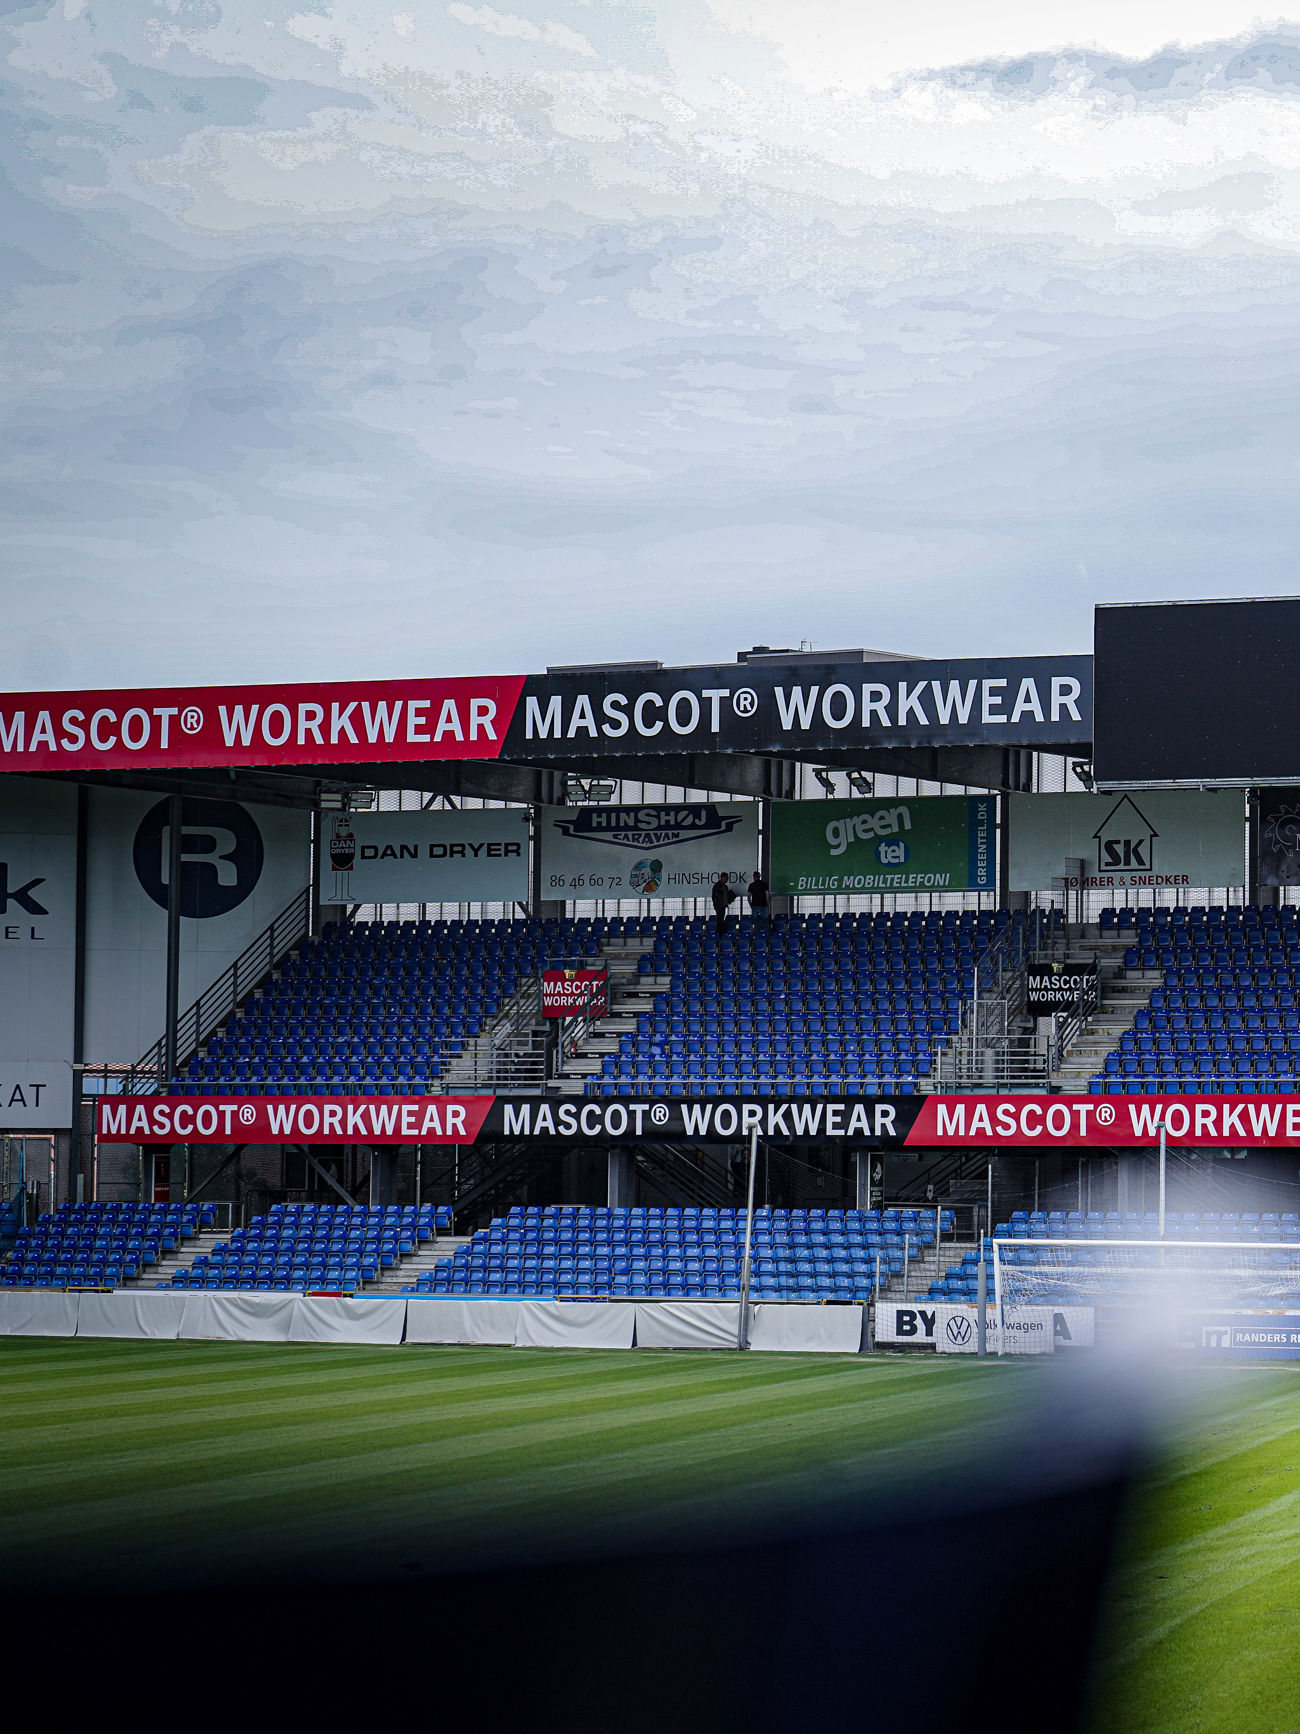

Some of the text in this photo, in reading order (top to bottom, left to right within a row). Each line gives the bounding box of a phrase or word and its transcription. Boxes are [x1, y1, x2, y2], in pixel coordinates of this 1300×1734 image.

[526, 677, 1082, 739] MASCOT® WORKWEAR
[0, 698, 497, 752] MASCOT® WORKWEAR
[592, 809, 707, 829] HINSHØJ
[825, 805, 912, 856] green
[331, 840, 354, 848] DAN
[612, 831, 680, 845] CARAVAN
[977, 802, 987, 884] GREENTEL.DK
[360, 842, 521, 860] DAN DRYER
[878, 841, 905, 864] tel
[1104, 838, 1146, 867] SK
[550, 873, 622, 889] 86 46 60 72
[798, 875, 839, 890] BILLIG
[842, 873, 950, 889] MOBILTELEFONI
[1119, 877, 1126, 886] &
[1130, 875, 1189, 886] SNEDKER
[0, 1084, 47, 1107] AT
[103, 1104, 466, 1135] MASCOT® WORKWEAR
[504, 1104, 896, 1136] MASCOT® WORKWEAR
[937, 1104, 1115, 1136] MASCOT®
[1236, 1332, 1287, 1343] RANDERS
